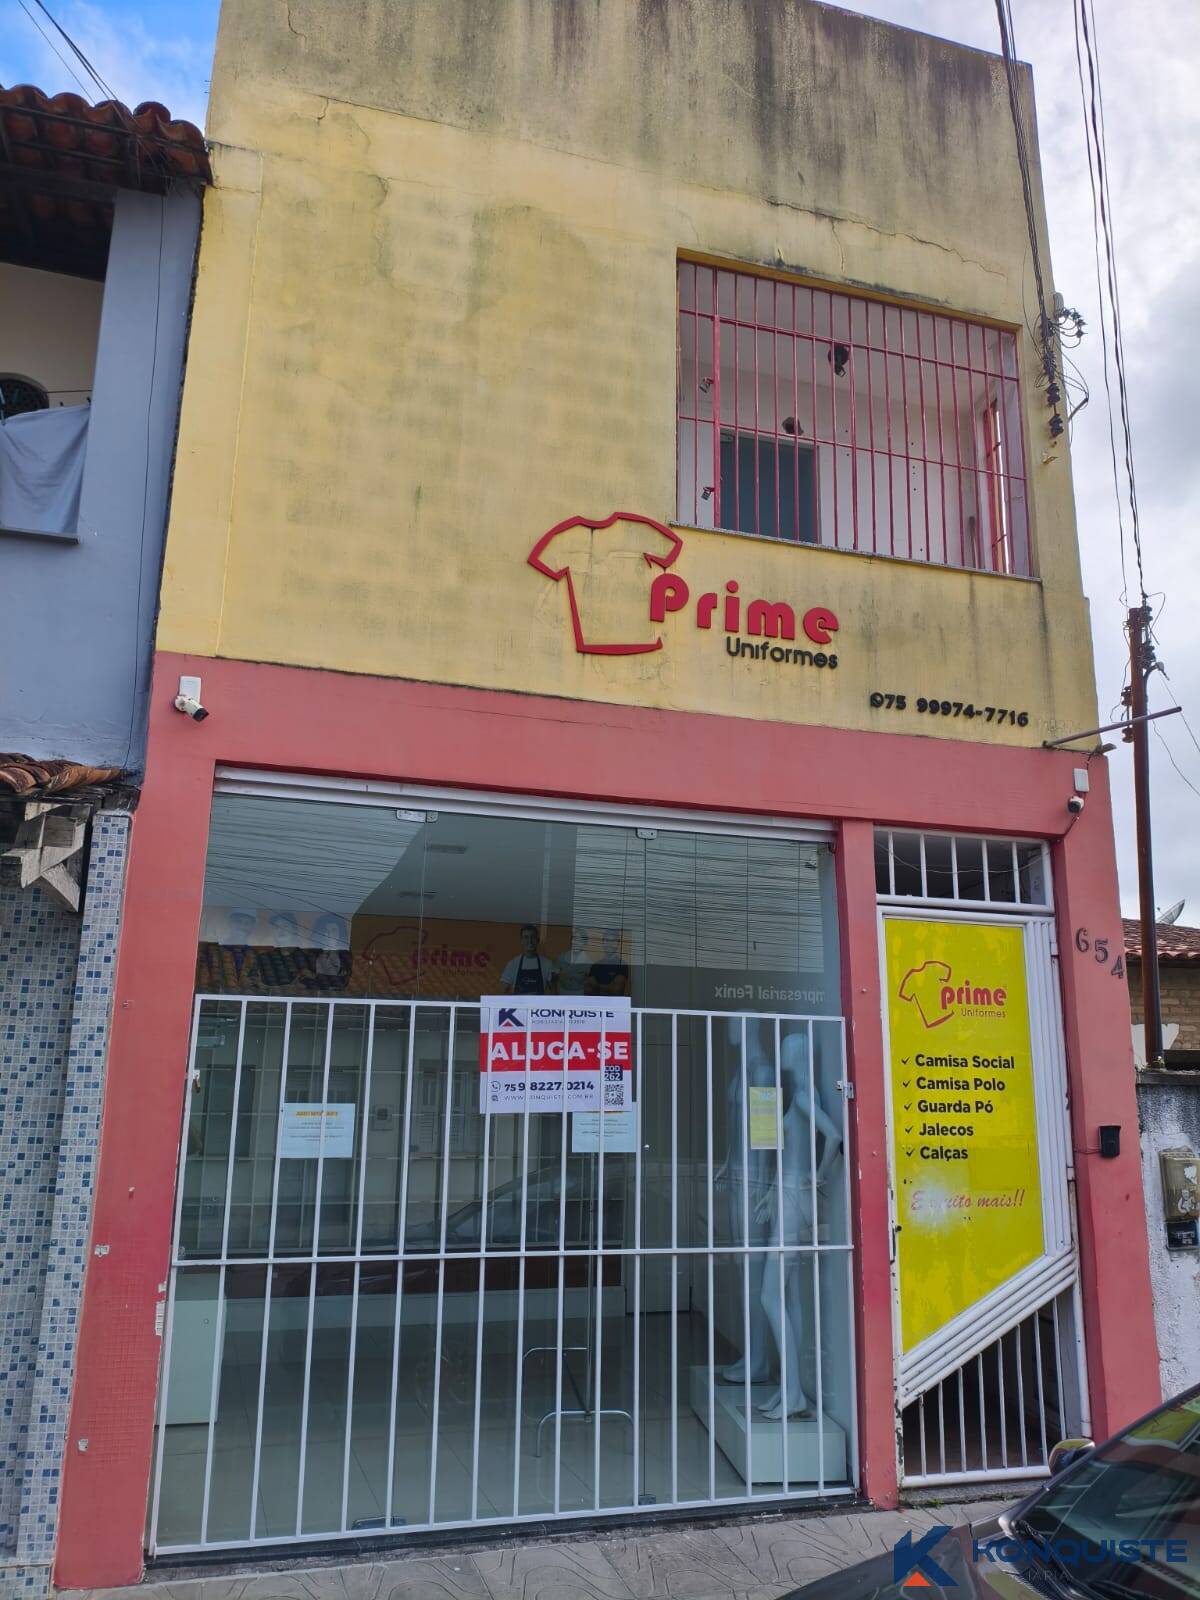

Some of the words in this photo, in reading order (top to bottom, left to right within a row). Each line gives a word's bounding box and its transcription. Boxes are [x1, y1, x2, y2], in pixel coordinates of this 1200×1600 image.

[726, 637, 838, 669] Uniformes
[917, 698, 1029, 727] 99974-7716
[1076, 928, 1124, 979] 654
[941, 980, 1007, 1010] prime
[961, 1008, 1006, 1018] Uniformes
[491, 1041, 629, 1061] ALUGA-SE
[915, 1054, 968, 1068] Camisa
[972, 1055, 1015, 1069] Social
[604, 1072, 621, 1081] 262
[916, 1076, 970, 1090] Camisa
[973, 1078, 1006, 1091] Polo
[918, 1099, 971, 1113] Guarda
[975, 1100, 994, 1113] Pó
[919, 1122, 974, 1136] Jalecos
[920, 1145, 969, 1161] Calças
[977, 1188, 1025, 1207] mais!!
